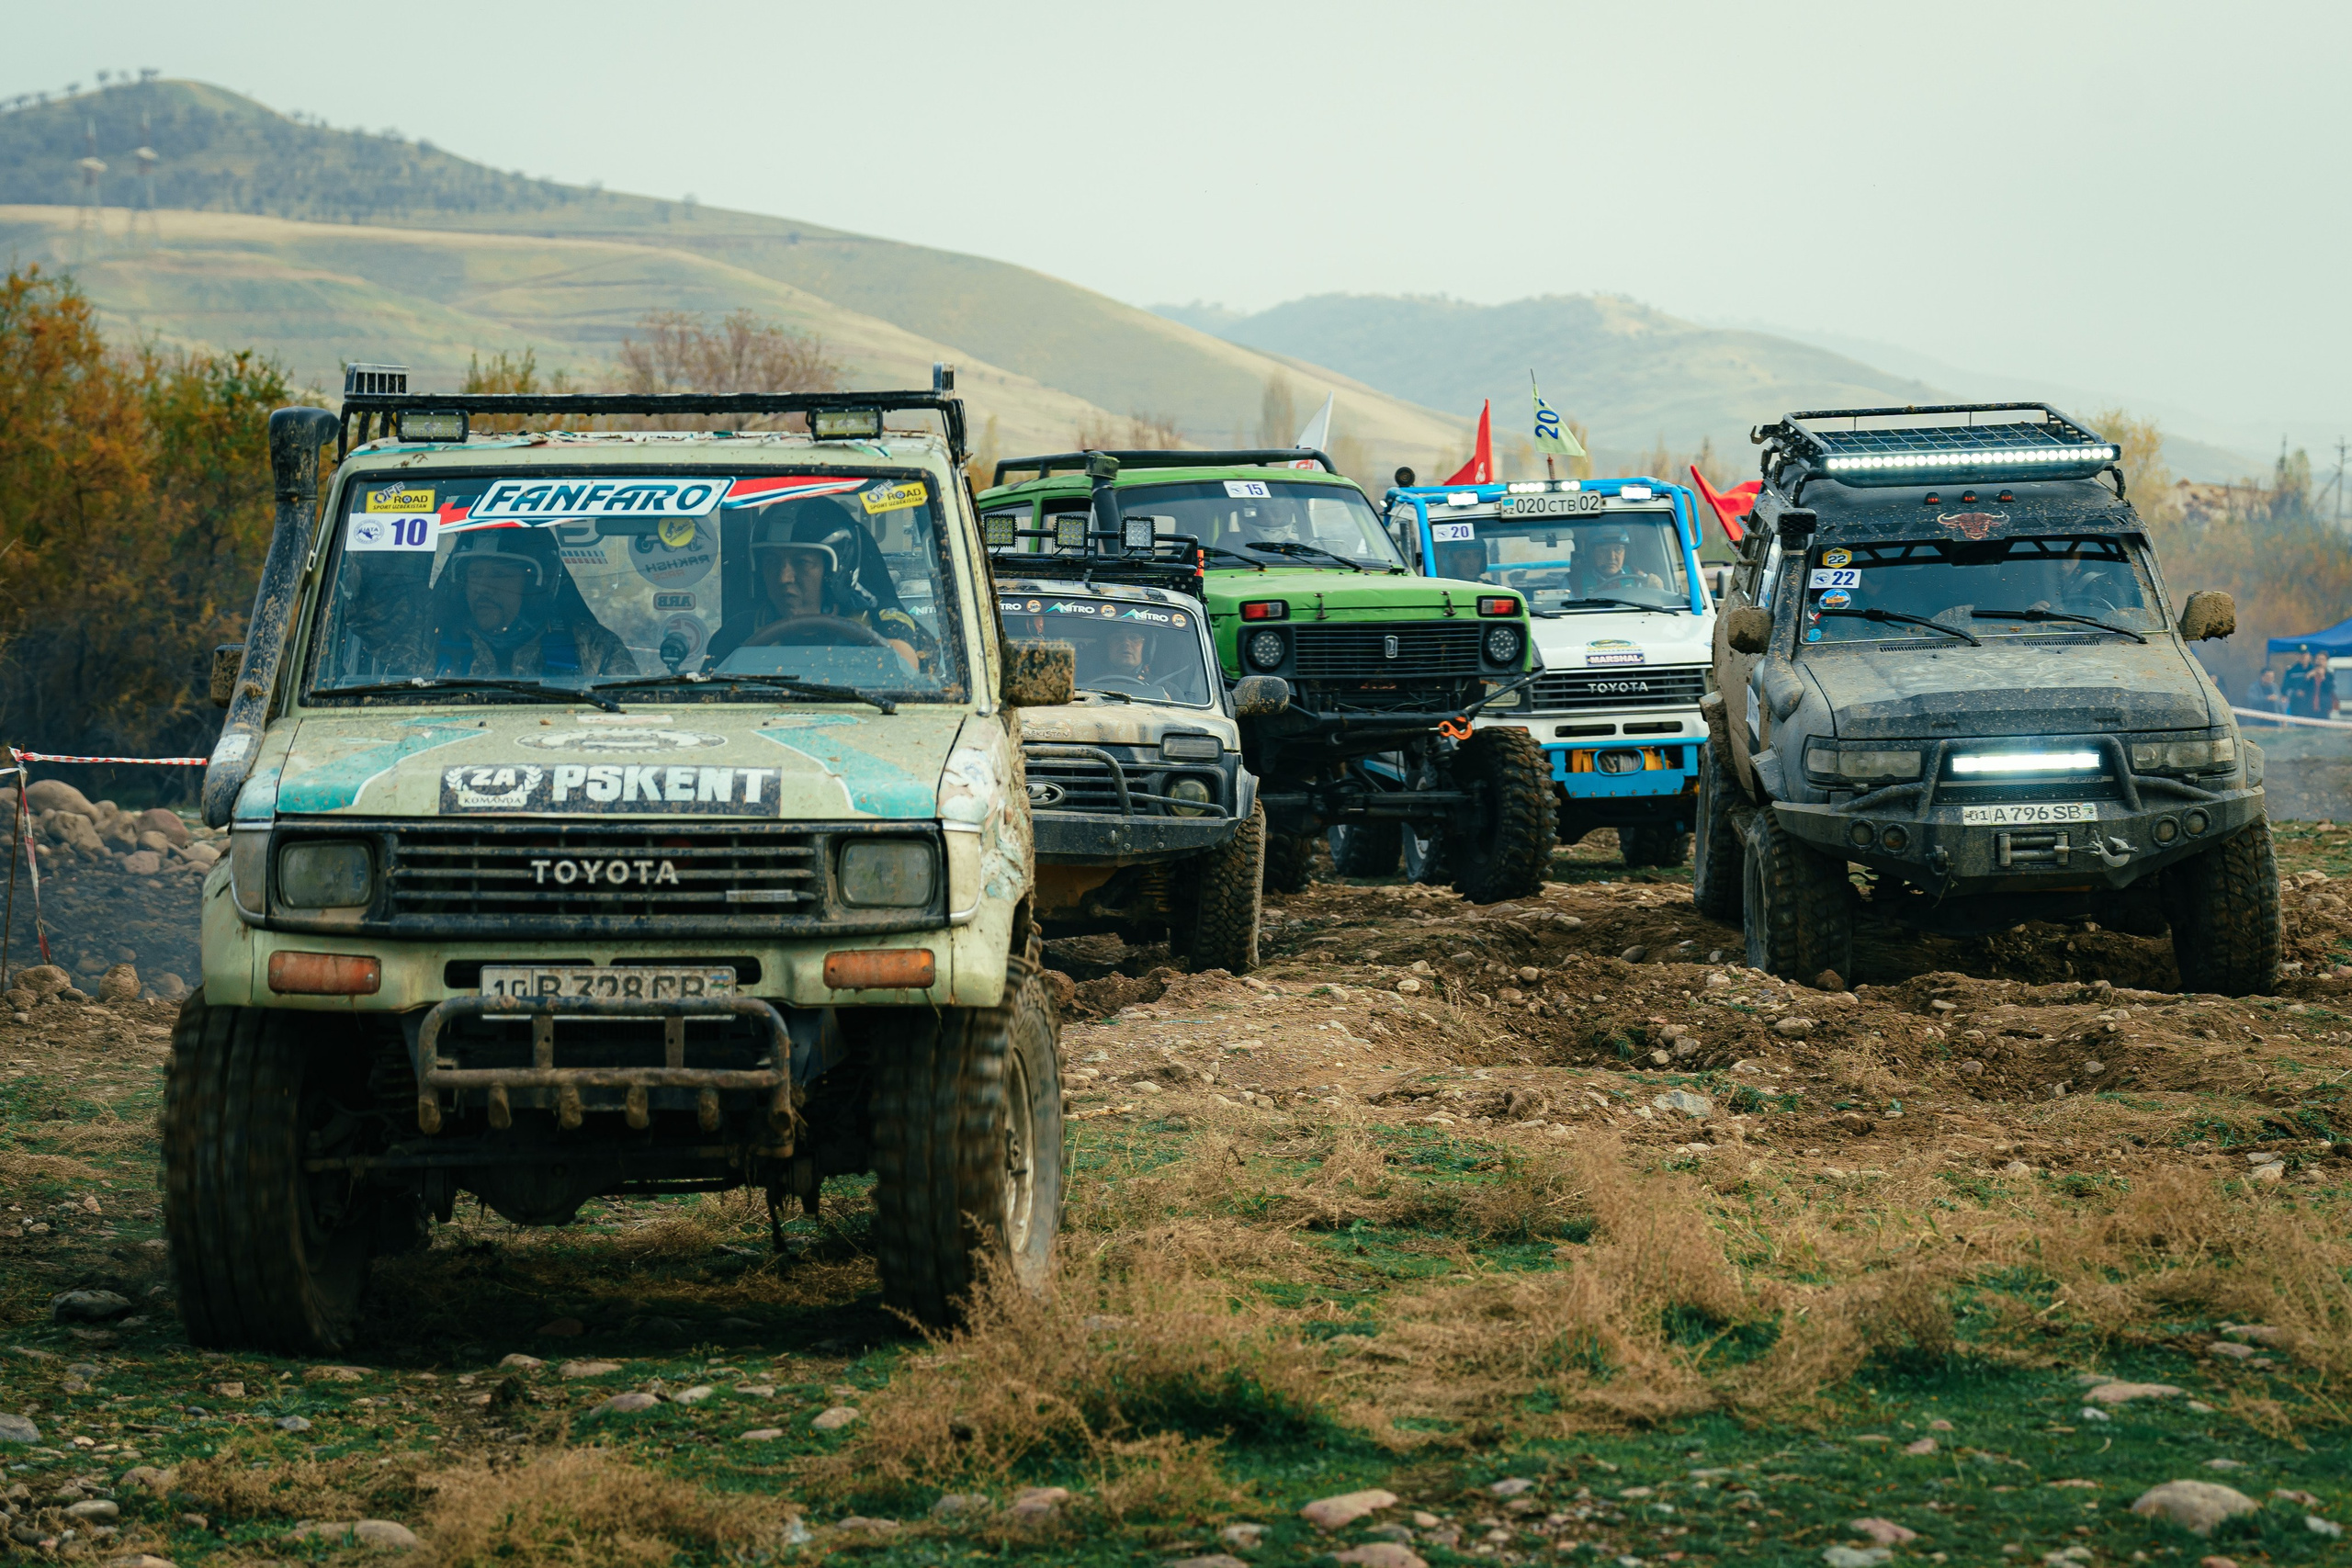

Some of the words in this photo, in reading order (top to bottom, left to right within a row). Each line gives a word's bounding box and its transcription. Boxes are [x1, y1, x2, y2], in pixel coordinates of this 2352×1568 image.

[373, 481, 405, 503] OFF
[393, 495, 428, 504] ROAD
[866, 479, 895, 502] OFF
[887, 488, 922, 501] ROAD
[1245, 483, 1264, 496] 15
[483, 484, 712, 512] FANFARO
[888, 497, 923, 507] UZBEKISTAN
[1516, 498, 1545, 513] 020
[1548, 500, 1577, 513] CTB
[1579, 495, 1599, 511] 02
[390, 518, 428, 546] 10
[1451, 525, 1469, 538] 20
[1827, 555, 1847, 564] 22
[1832, 570, 1855, 585] 22
[999, 600, 1022, 610] TRO
[1059, 602, 1095, 615] NITRO
[1133, 609, 1169, 623] NITRO
[1589, 654, 1641, 663] MARSHAL
[1588, 682, 1648, 694] TOYOTA
[469, 768, 516, 786] ZA
[2067, 775, 2103, 784] RAPTOR
[463, 796, 522, 805] KOMANDA
[1994, 808, 2007, 822] A
[2010, 806, 2050, 821] 796
[2053, 806, 2081, 820] SB
[531, 860, 679, 885] TOYOTA
